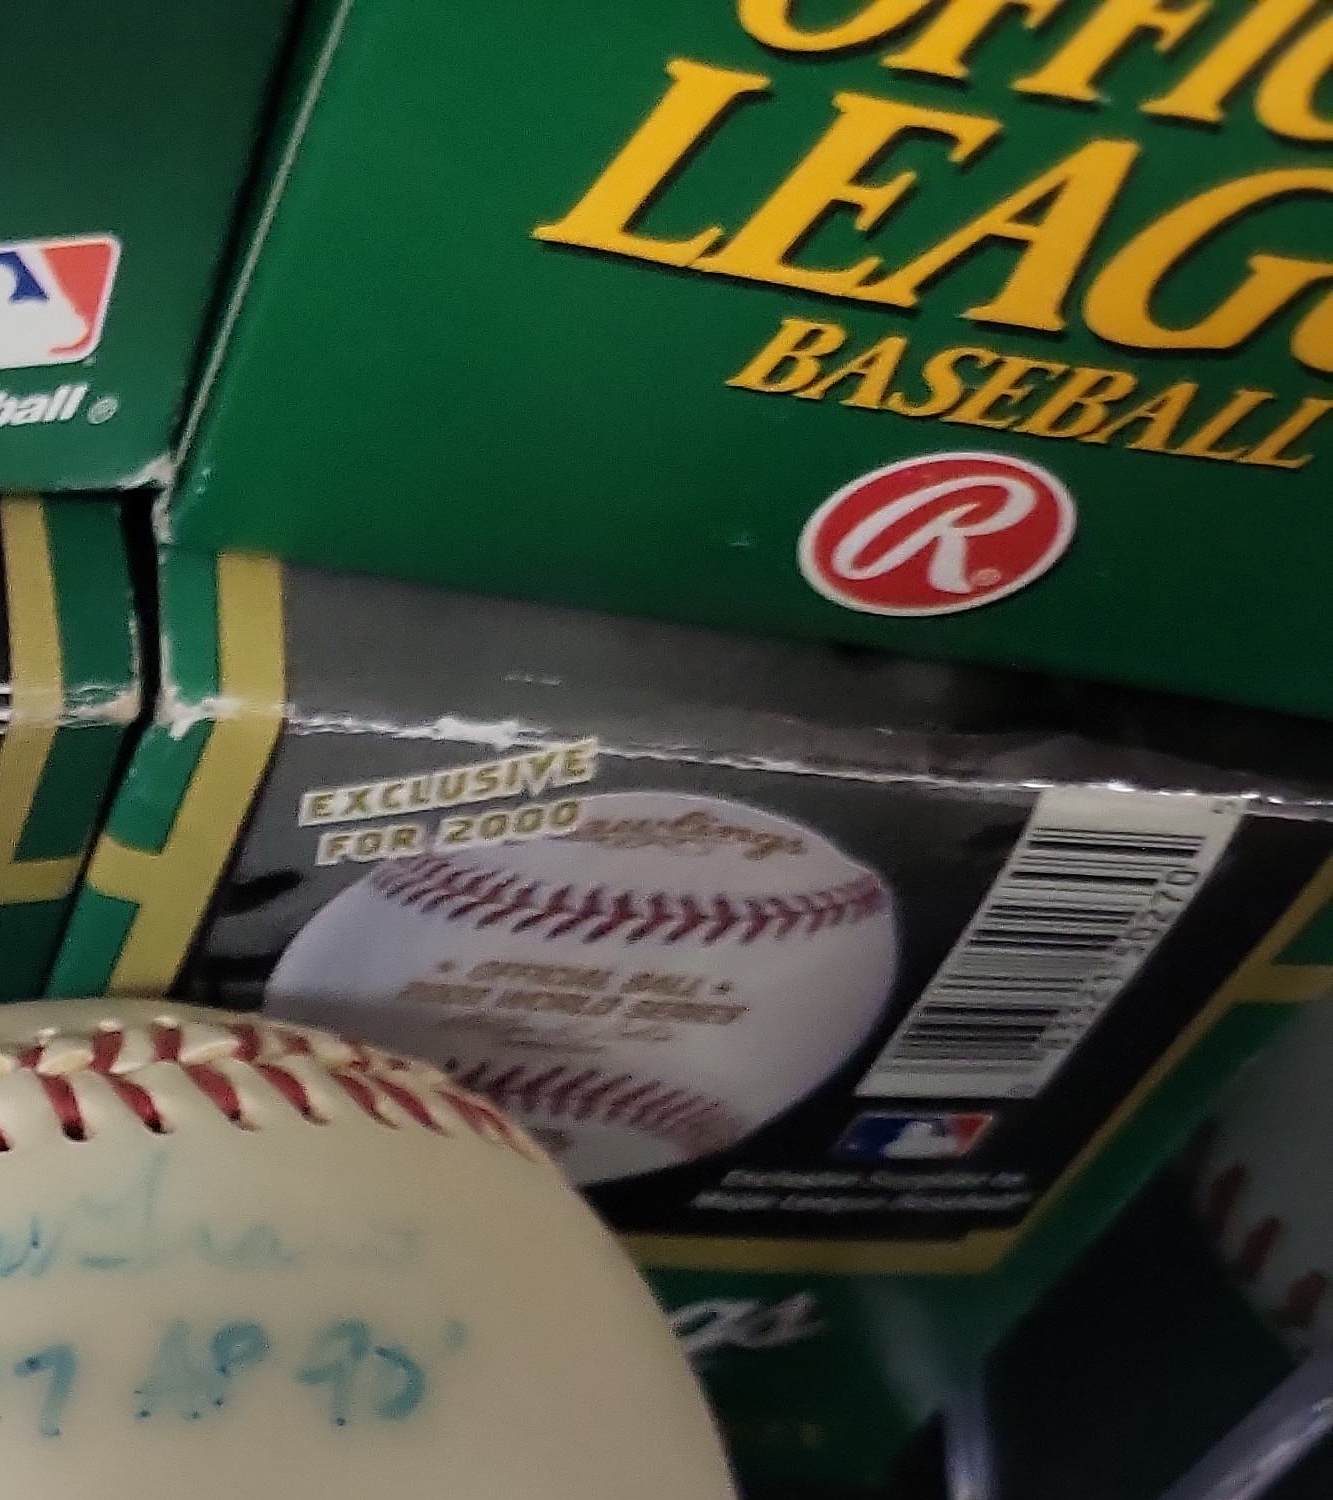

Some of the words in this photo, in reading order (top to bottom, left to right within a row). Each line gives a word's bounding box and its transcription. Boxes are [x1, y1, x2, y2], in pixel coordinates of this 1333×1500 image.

[533, 57, 1333, 374] LEAG
[726, 317, 1333, 470] BASEBALL
[310, 747, 588, 817] EXCLUSIVE
[326, 828, 418, 856] FOR
[443, 799, 580, 844] 2000
